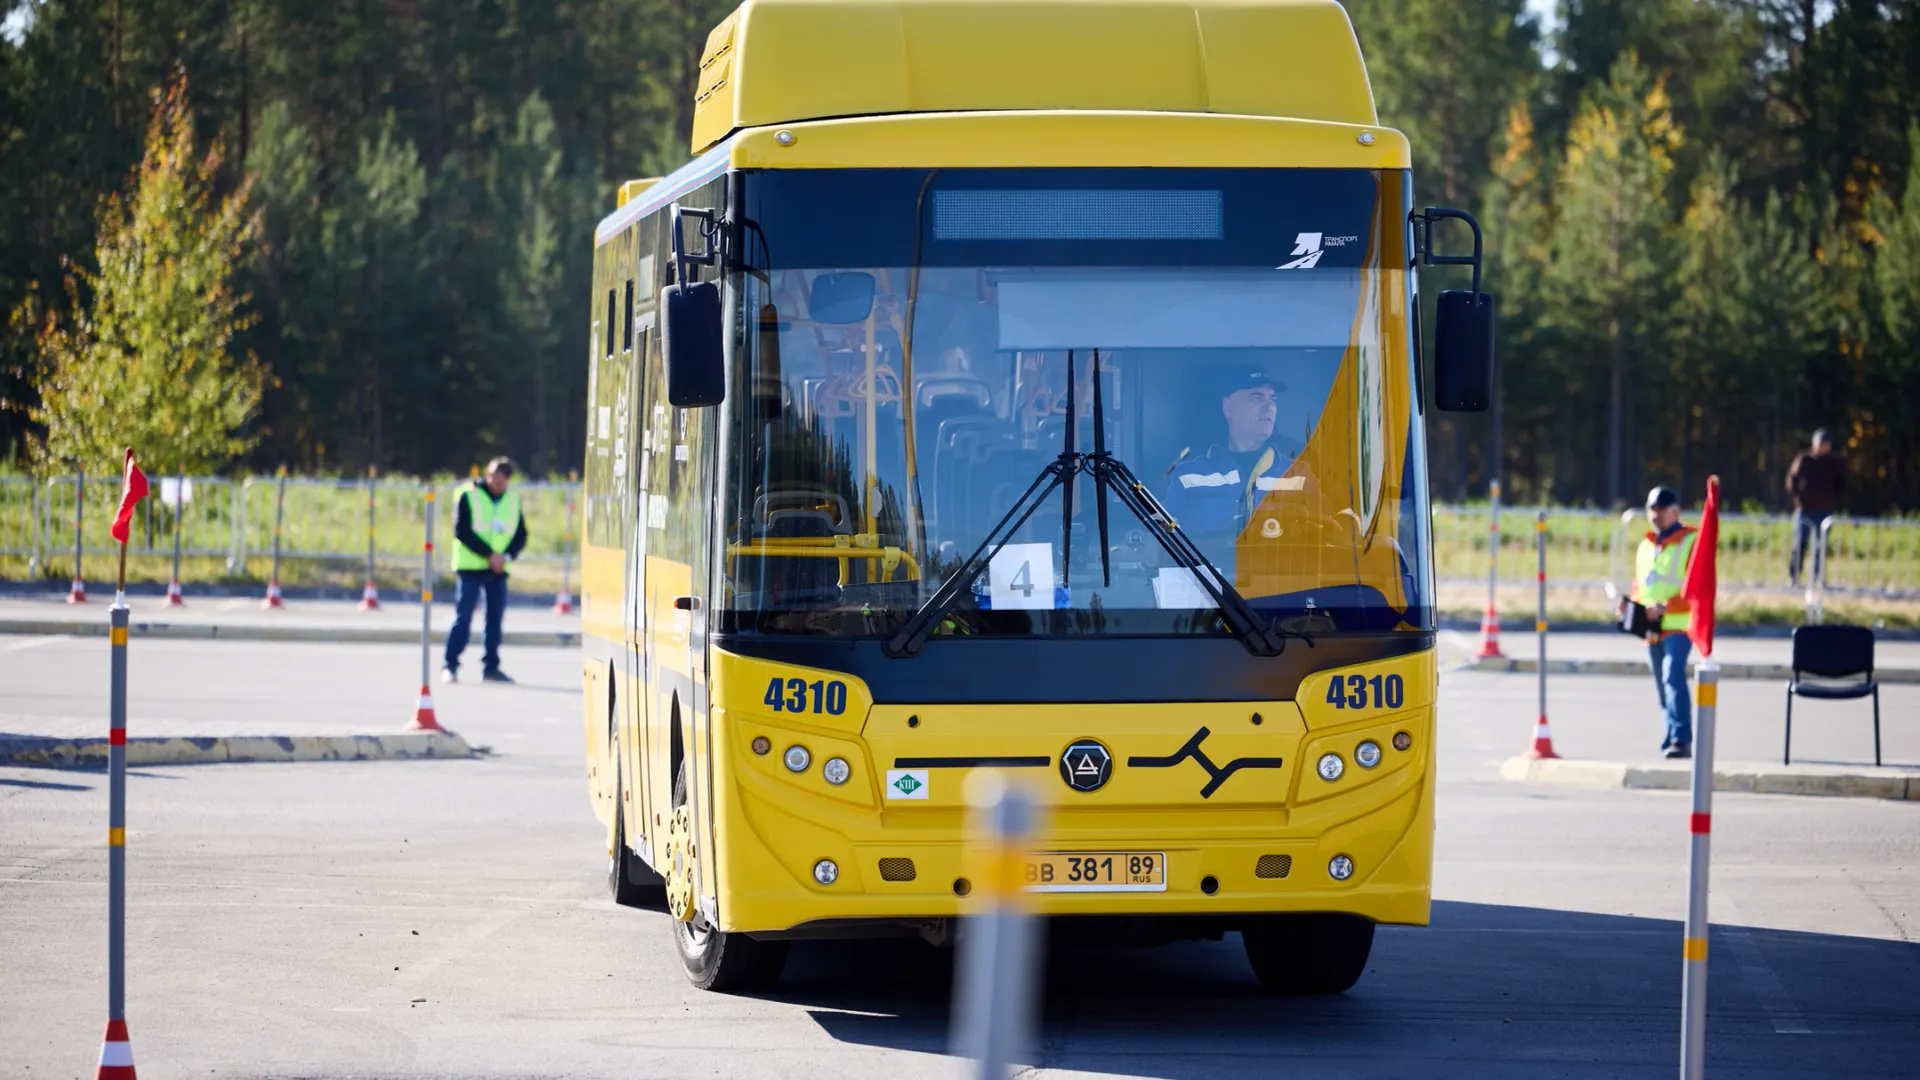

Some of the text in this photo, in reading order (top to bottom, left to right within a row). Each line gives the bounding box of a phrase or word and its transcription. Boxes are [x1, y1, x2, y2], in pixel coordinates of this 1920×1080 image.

[1010, 560, 1035, 597] 4
[763, 677, 847, 715] 4310
[1326, 673, 1404, 709] 4310
[899, 779, 917, 790] КПГ
[1067, 857, 1112, 882] 381
[1129, 856, 1154, 875] 89
[1132, 875, 1152, 883] RUS
